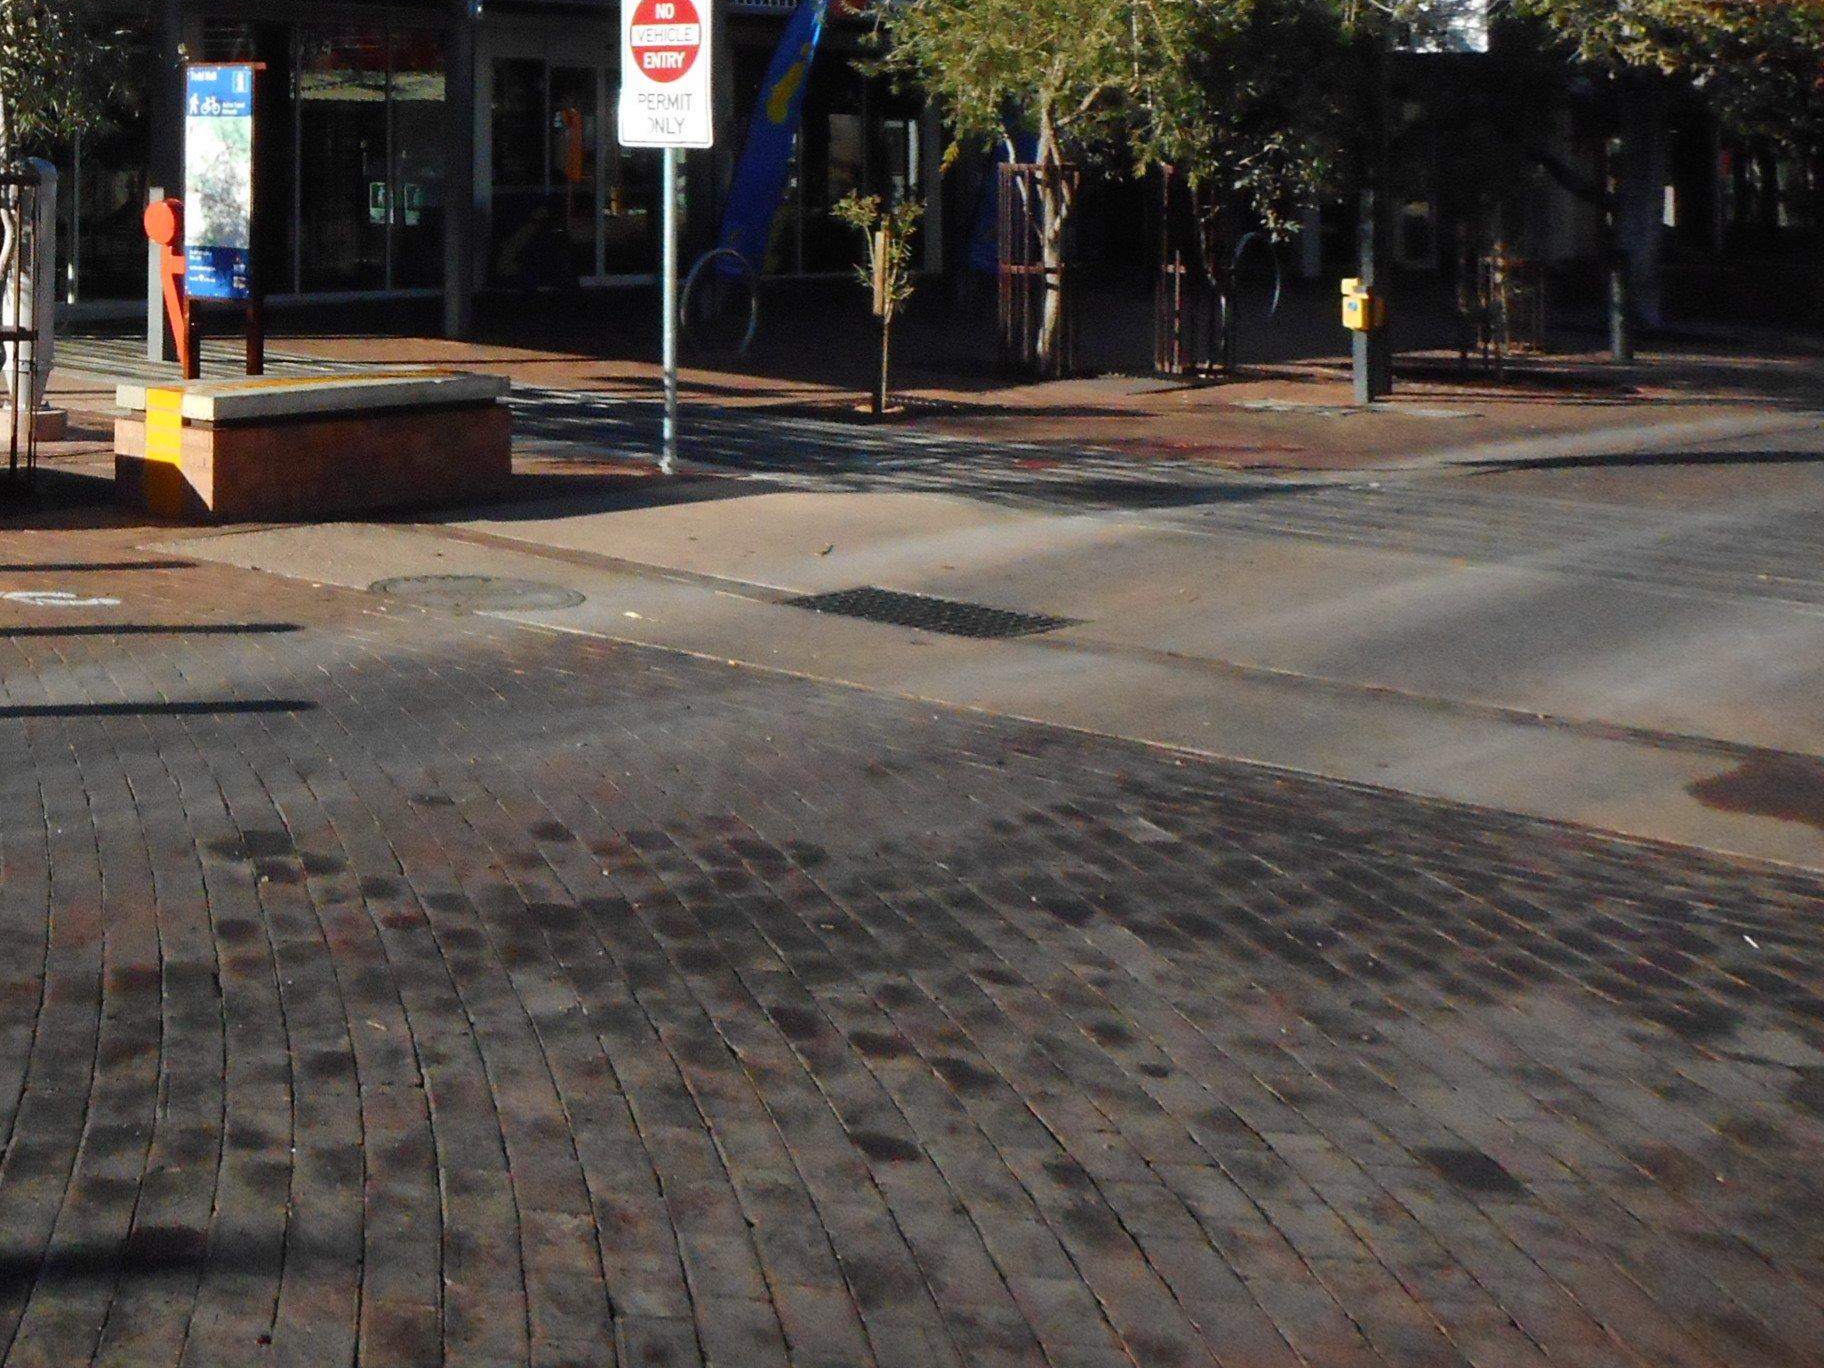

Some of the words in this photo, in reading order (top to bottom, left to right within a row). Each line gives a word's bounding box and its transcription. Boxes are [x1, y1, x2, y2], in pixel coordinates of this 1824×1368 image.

[655, 3, 675, 20] NO
[637, 27, 693, 43] VEHICLE
[642, 51, 686, 70] ENTRY
[638, 93, 692, 111] PERMIT
